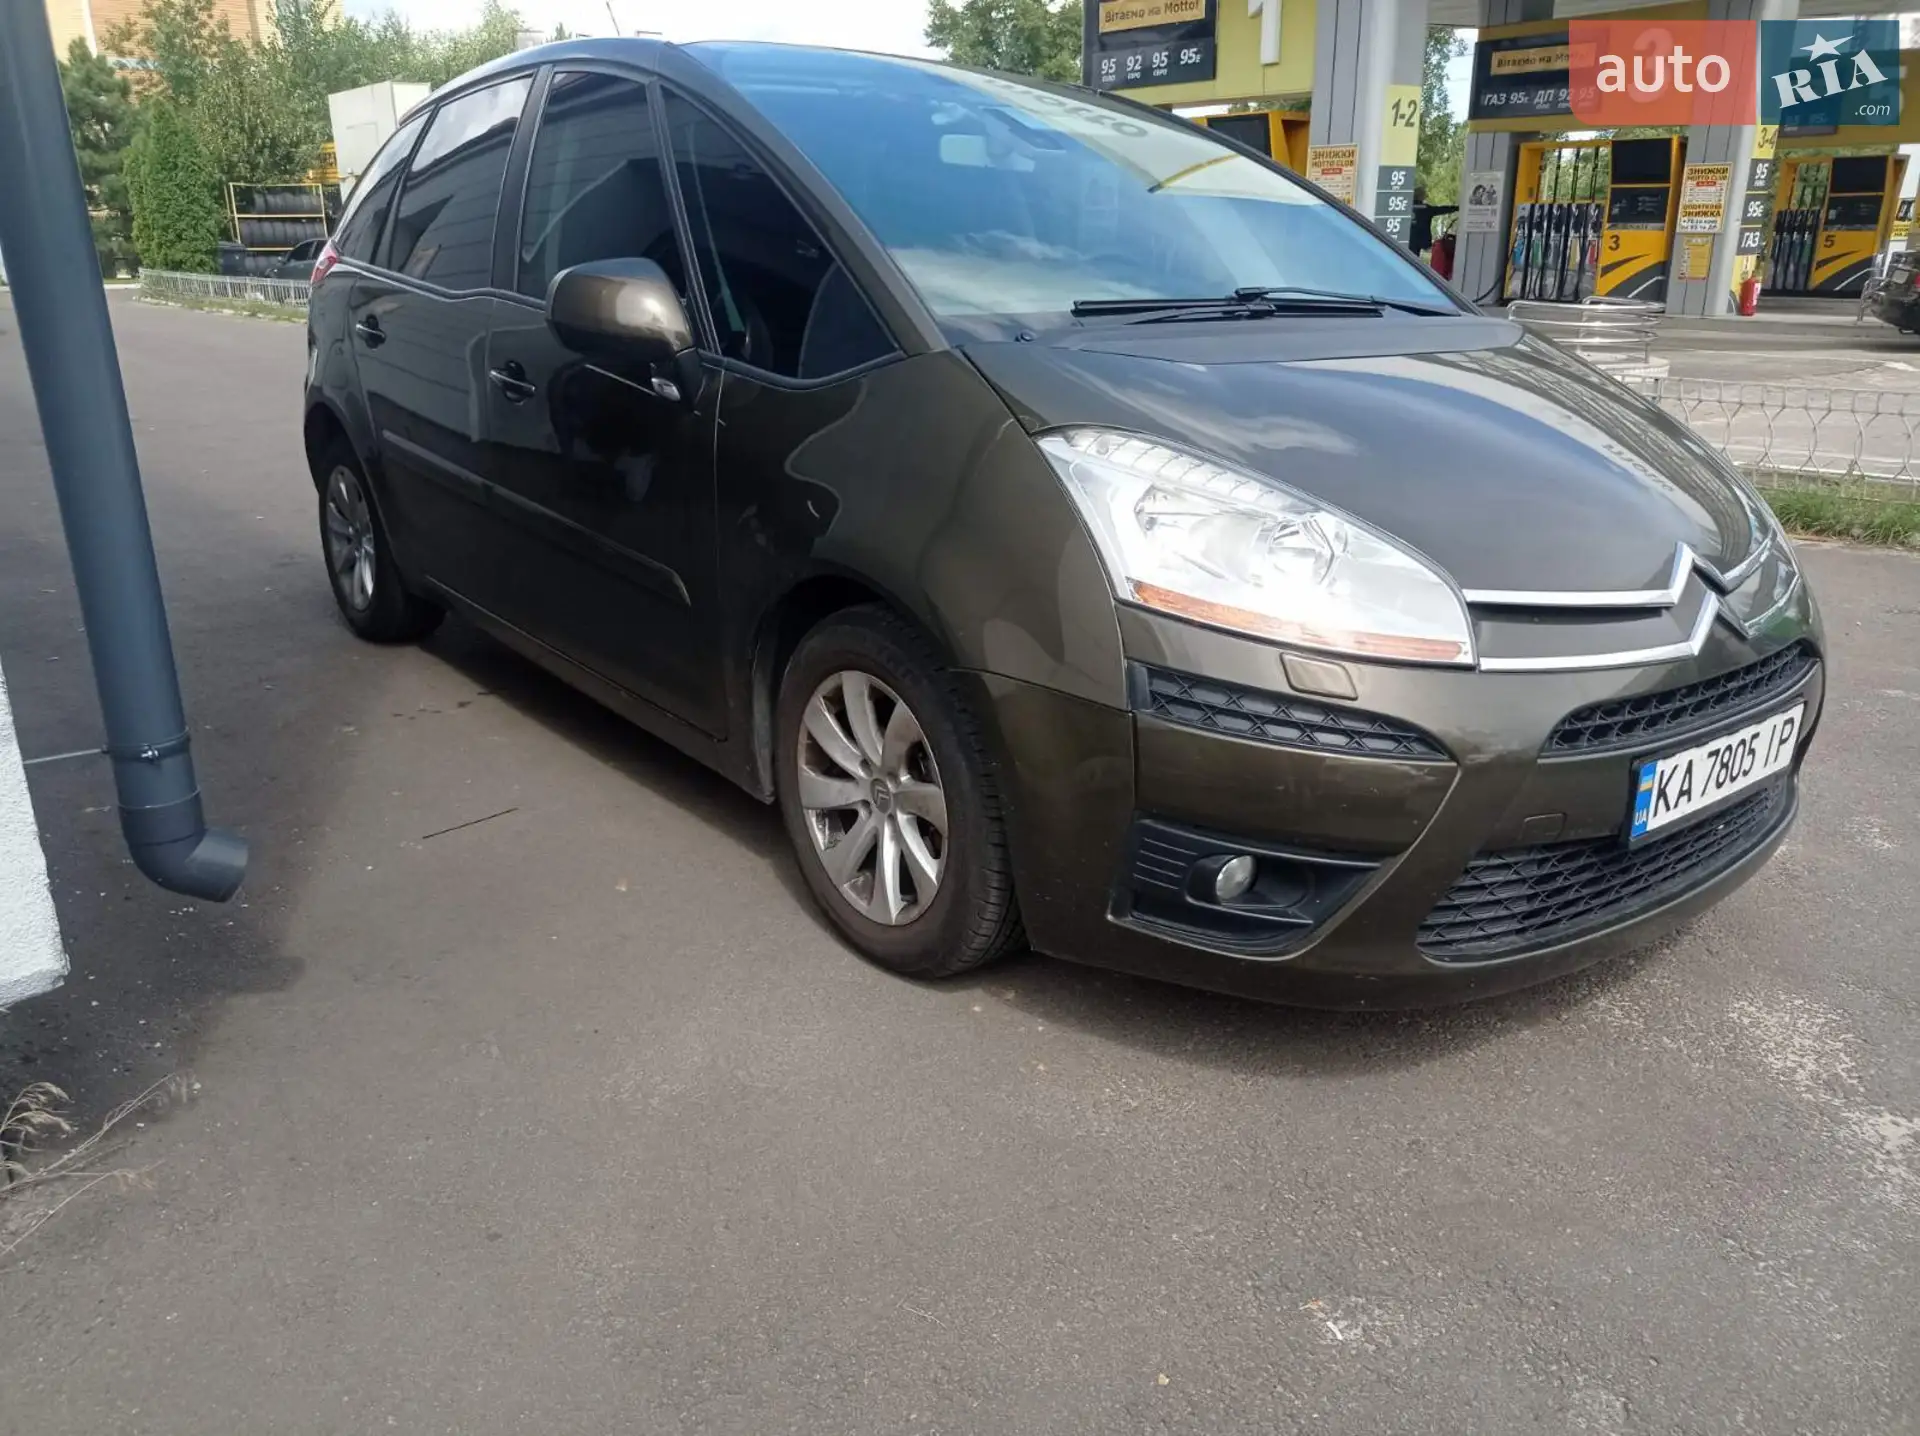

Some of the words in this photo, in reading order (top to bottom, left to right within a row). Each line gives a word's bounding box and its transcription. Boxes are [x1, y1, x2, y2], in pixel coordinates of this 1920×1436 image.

[1248, 0, 1283, 66] 1
[1101, 58, 1116, 74] 95
[1126, 55, 1142, 71] 92
[1152, 52, 1168, 68] 95
[1484, 93, 1506, 106] ГАЗ
[1534, 89, 1554, 105] ДП
[1391, 99, 1417, 127] 1-2
[1758, 128, 1778, 149] 3-4
[1312, 149, 1355, 159] ЗНИЖКИ
[1391, 171, 1406, 186] 95
[1687, 167, 1729, 175] ЗНИЖКИ
[1755, 163, 1769, 179] 95
[1682, 210, 1721, 218] ЗНИЖКА
[1386, 218, 1401, 232] 95
[1609, 235, 1621, 251] 3
[1741, 232, 1760, 248] ГАЗ
[1824, 235, 1836, 248] 5
[1653, 759, 1694, 818] KA
[1701, 732, 1760, 797] 7805
[1763, 716, 1795, 768] IP
[1635, 810, 1647, 825] UA
